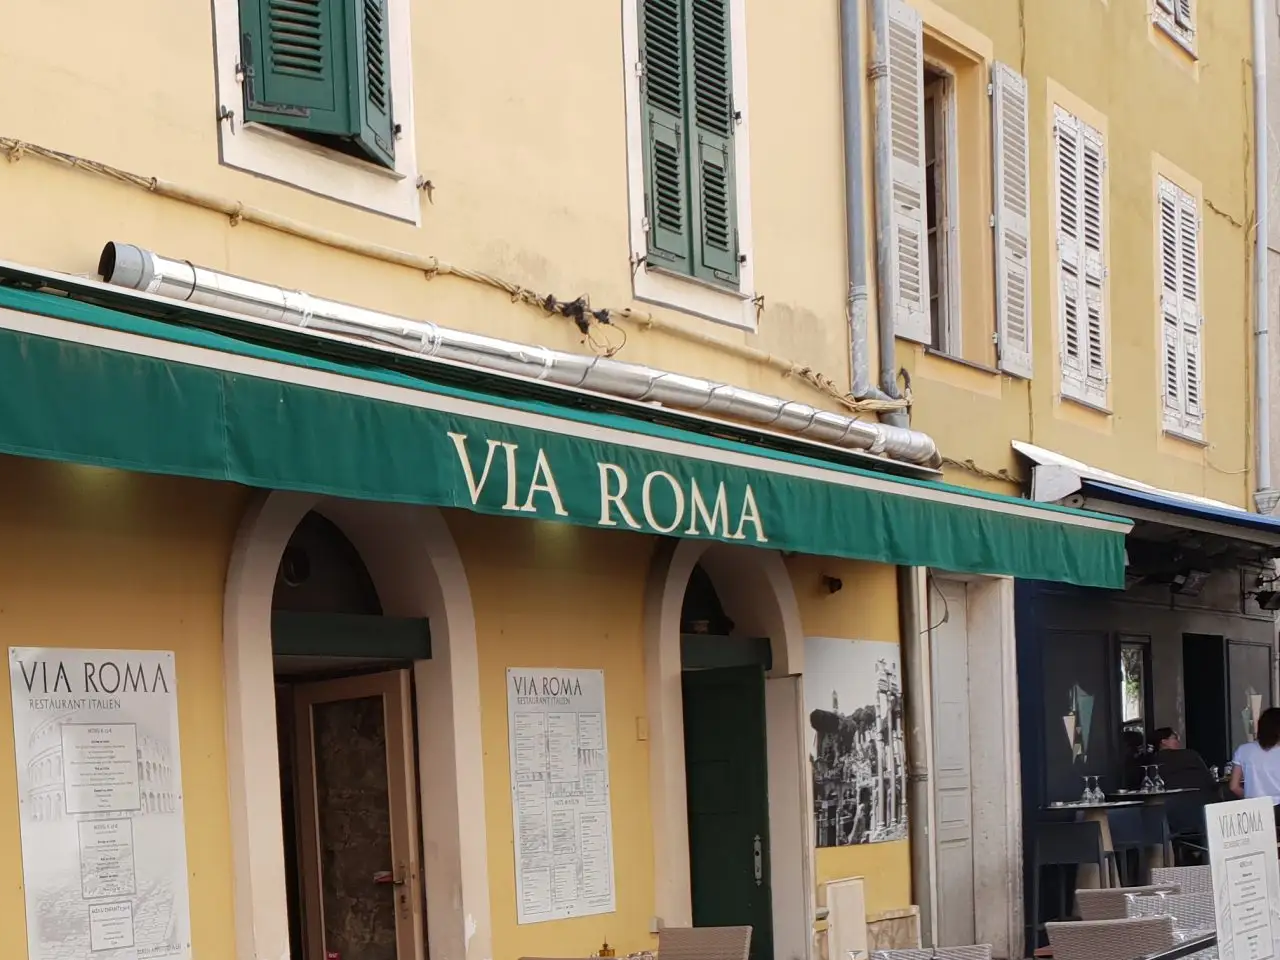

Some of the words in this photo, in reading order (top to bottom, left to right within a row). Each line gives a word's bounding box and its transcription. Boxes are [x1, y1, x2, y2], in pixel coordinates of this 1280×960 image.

[447, 431, 569, 517] VIA
[596, 461, 769, 543] ROMA
[18, 660, 73, 693] VIA
[84, 661, 170, 694] ROMA
[513, 676, 538, 696] VIA
[542, 676, 583, 696] ROMA
[28, 698, 86, 710] RESTAURANT
[88, 698, 121, 710] ITALIEN
[1219, 814, 1236, 838] VIA
[1237, 810, 1264, 835] ROMA
